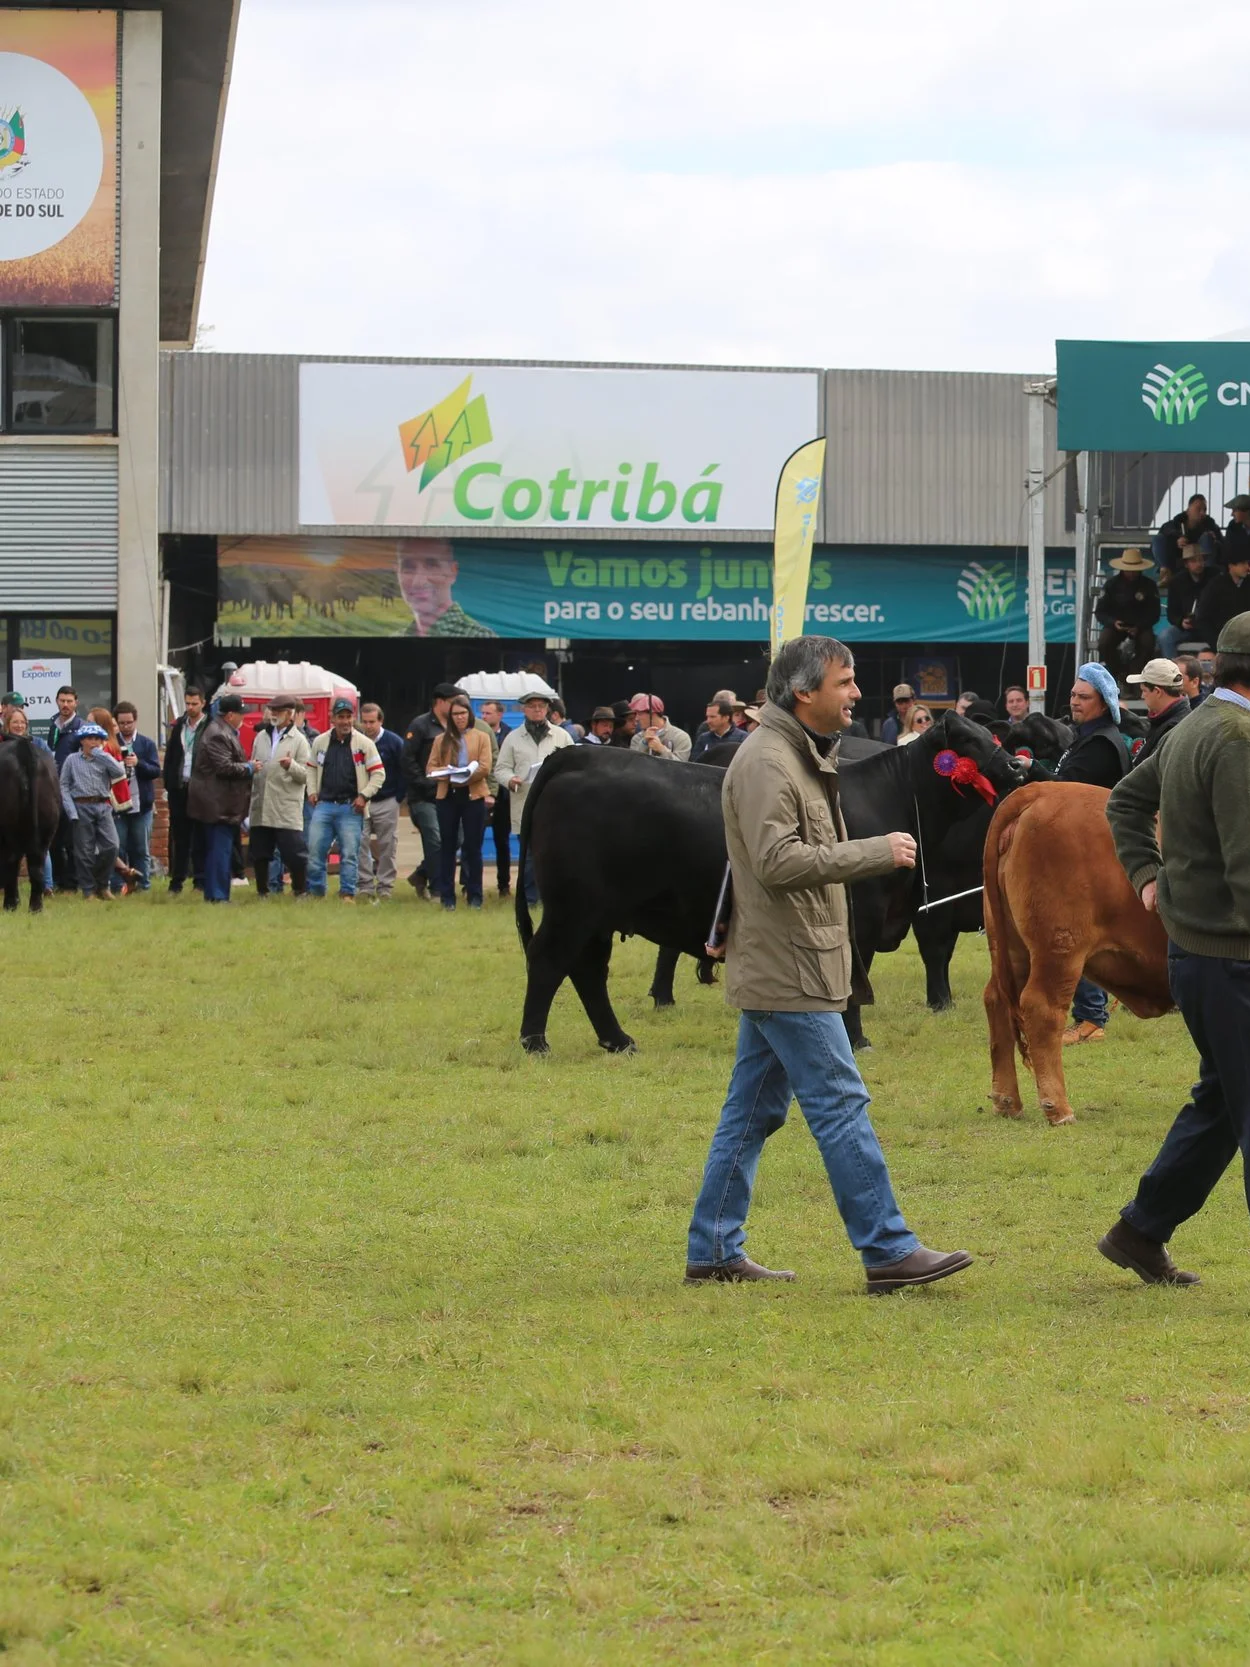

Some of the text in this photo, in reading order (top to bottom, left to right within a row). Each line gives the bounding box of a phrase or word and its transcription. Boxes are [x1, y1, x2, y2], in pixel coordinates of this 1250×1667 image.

[16, 188, 65, 200] ESTADO
[16, 204, 35, 218] DO
[38, 204, 65, 218] SUL
[453, 461, 724, 524] Cotribá
[543, 548, 832, 599] Vamos juns
[544, 601, 600, 624] para
[607, 603, 624, 621] o
[630, 602, 674, 621] seu
[804, 603, 885, 623] rescer.
[1051, 600, 1077, 616] Gra
[22, 670, 61, 680] Expointer
[25, 696, 52, 705] ISTA
